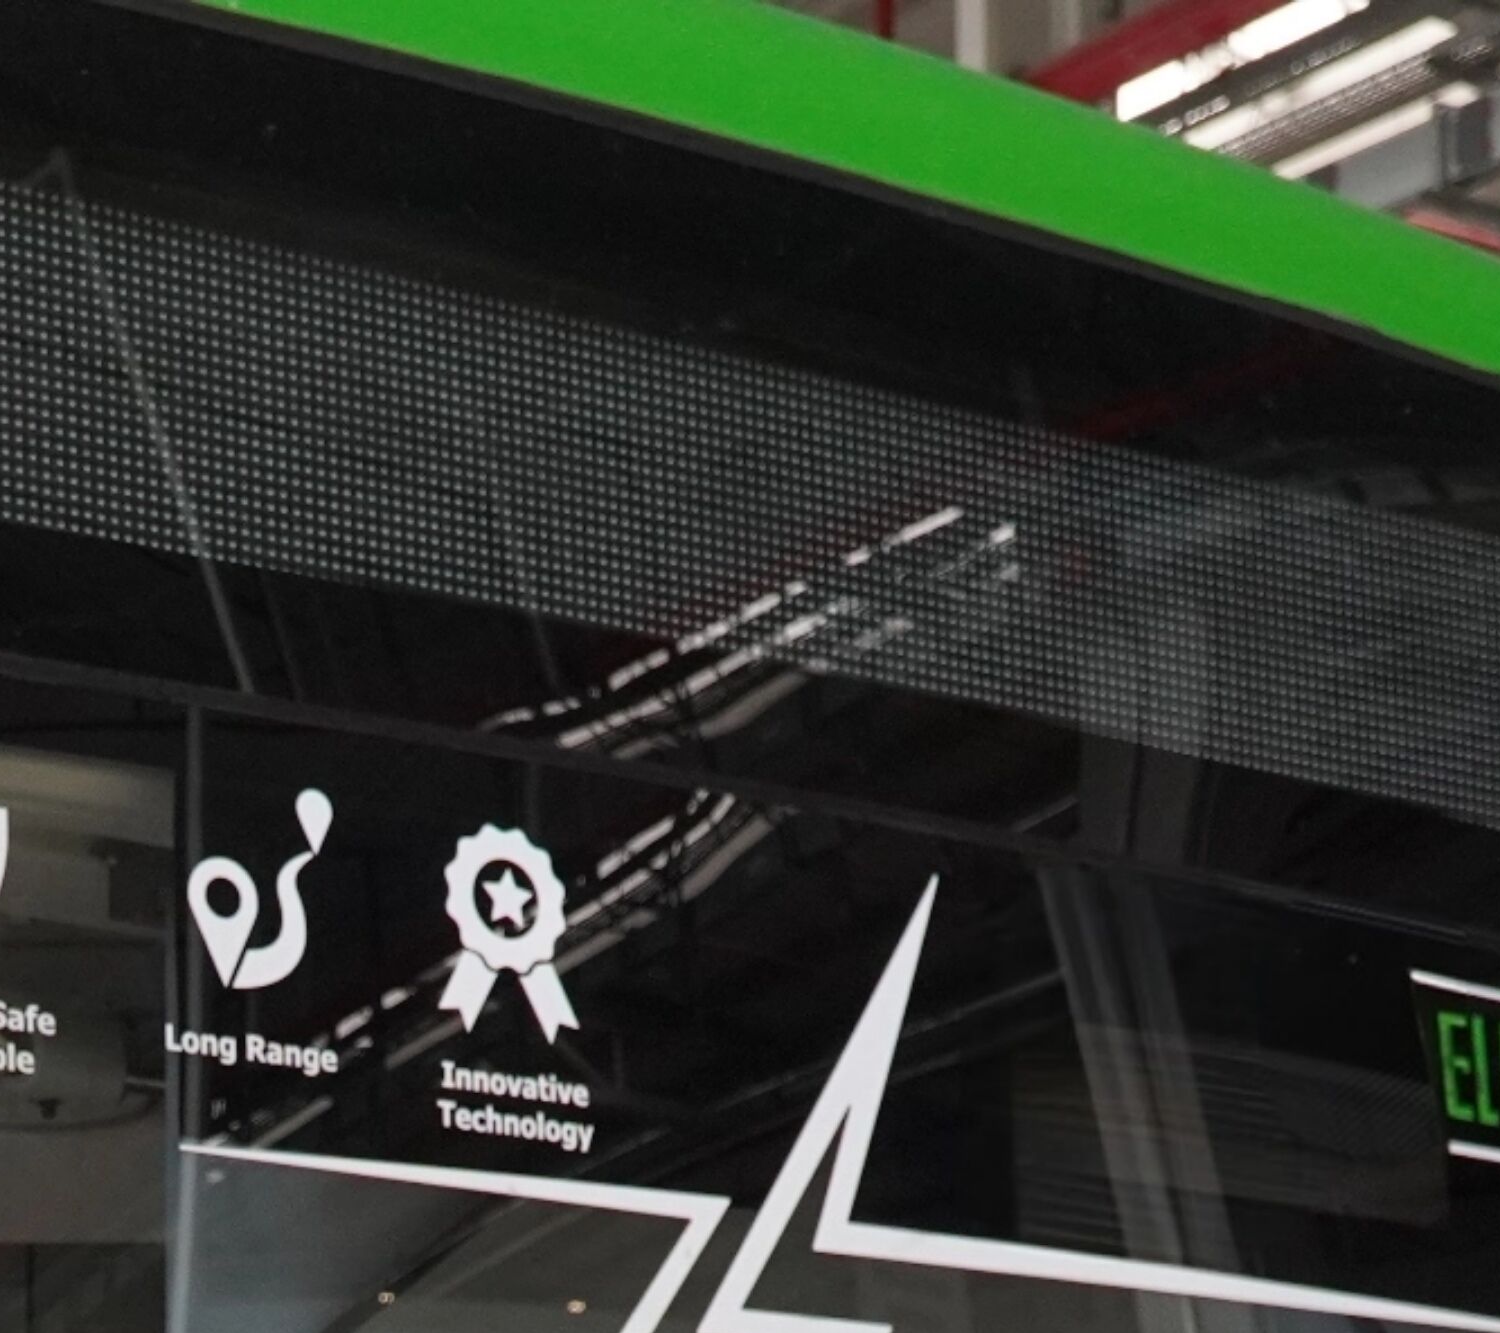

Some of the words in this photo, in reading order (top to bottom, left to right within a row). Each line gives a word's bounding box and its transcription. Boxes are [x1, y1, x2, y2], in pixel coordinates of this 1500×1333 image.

[164, 1022, 238, 1066] Long
[245, 1033, 339, 1077] Range
[440, 1060, 590, 1108] Innovative
[436, 1099, 595, 1153] Technology
